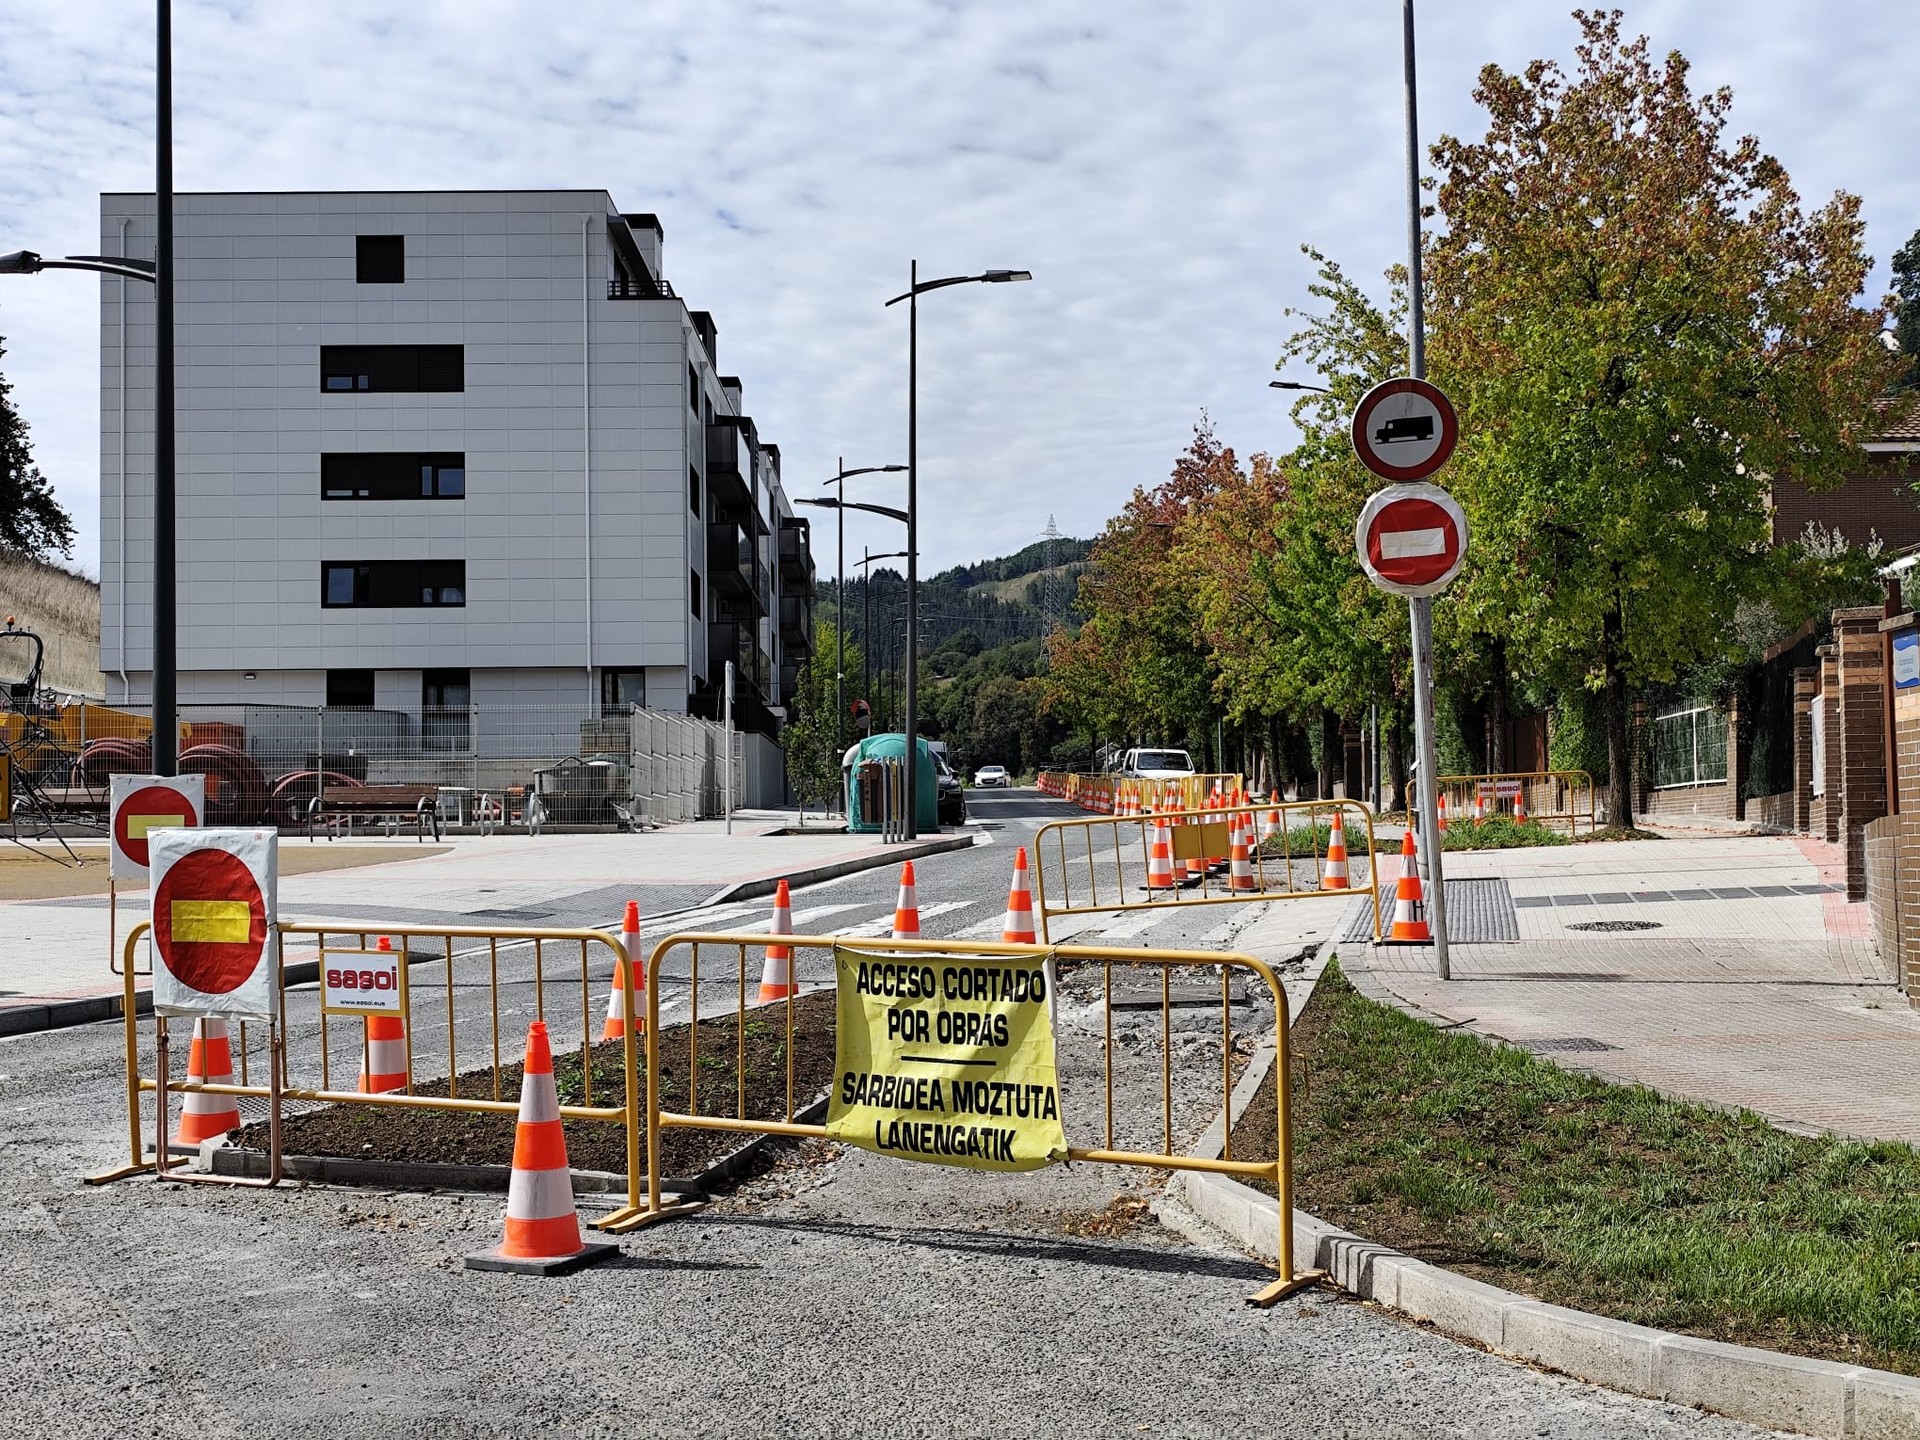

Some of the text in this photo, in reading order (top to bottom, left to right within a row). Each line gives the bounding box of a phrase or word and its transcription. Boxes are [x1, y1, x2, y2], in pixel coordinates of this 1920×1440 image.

[327, 966, 397, 990] sasoi
[856, 962, 1046, 1003] ACCESO CORTADO
[888, 1008, 1009, 1047] POR OBRAS
[842, 1071, 1058, 1120] SARBIDEA MOZTUTA
[876, 1119, 1016, 1162] LANENGATIK
